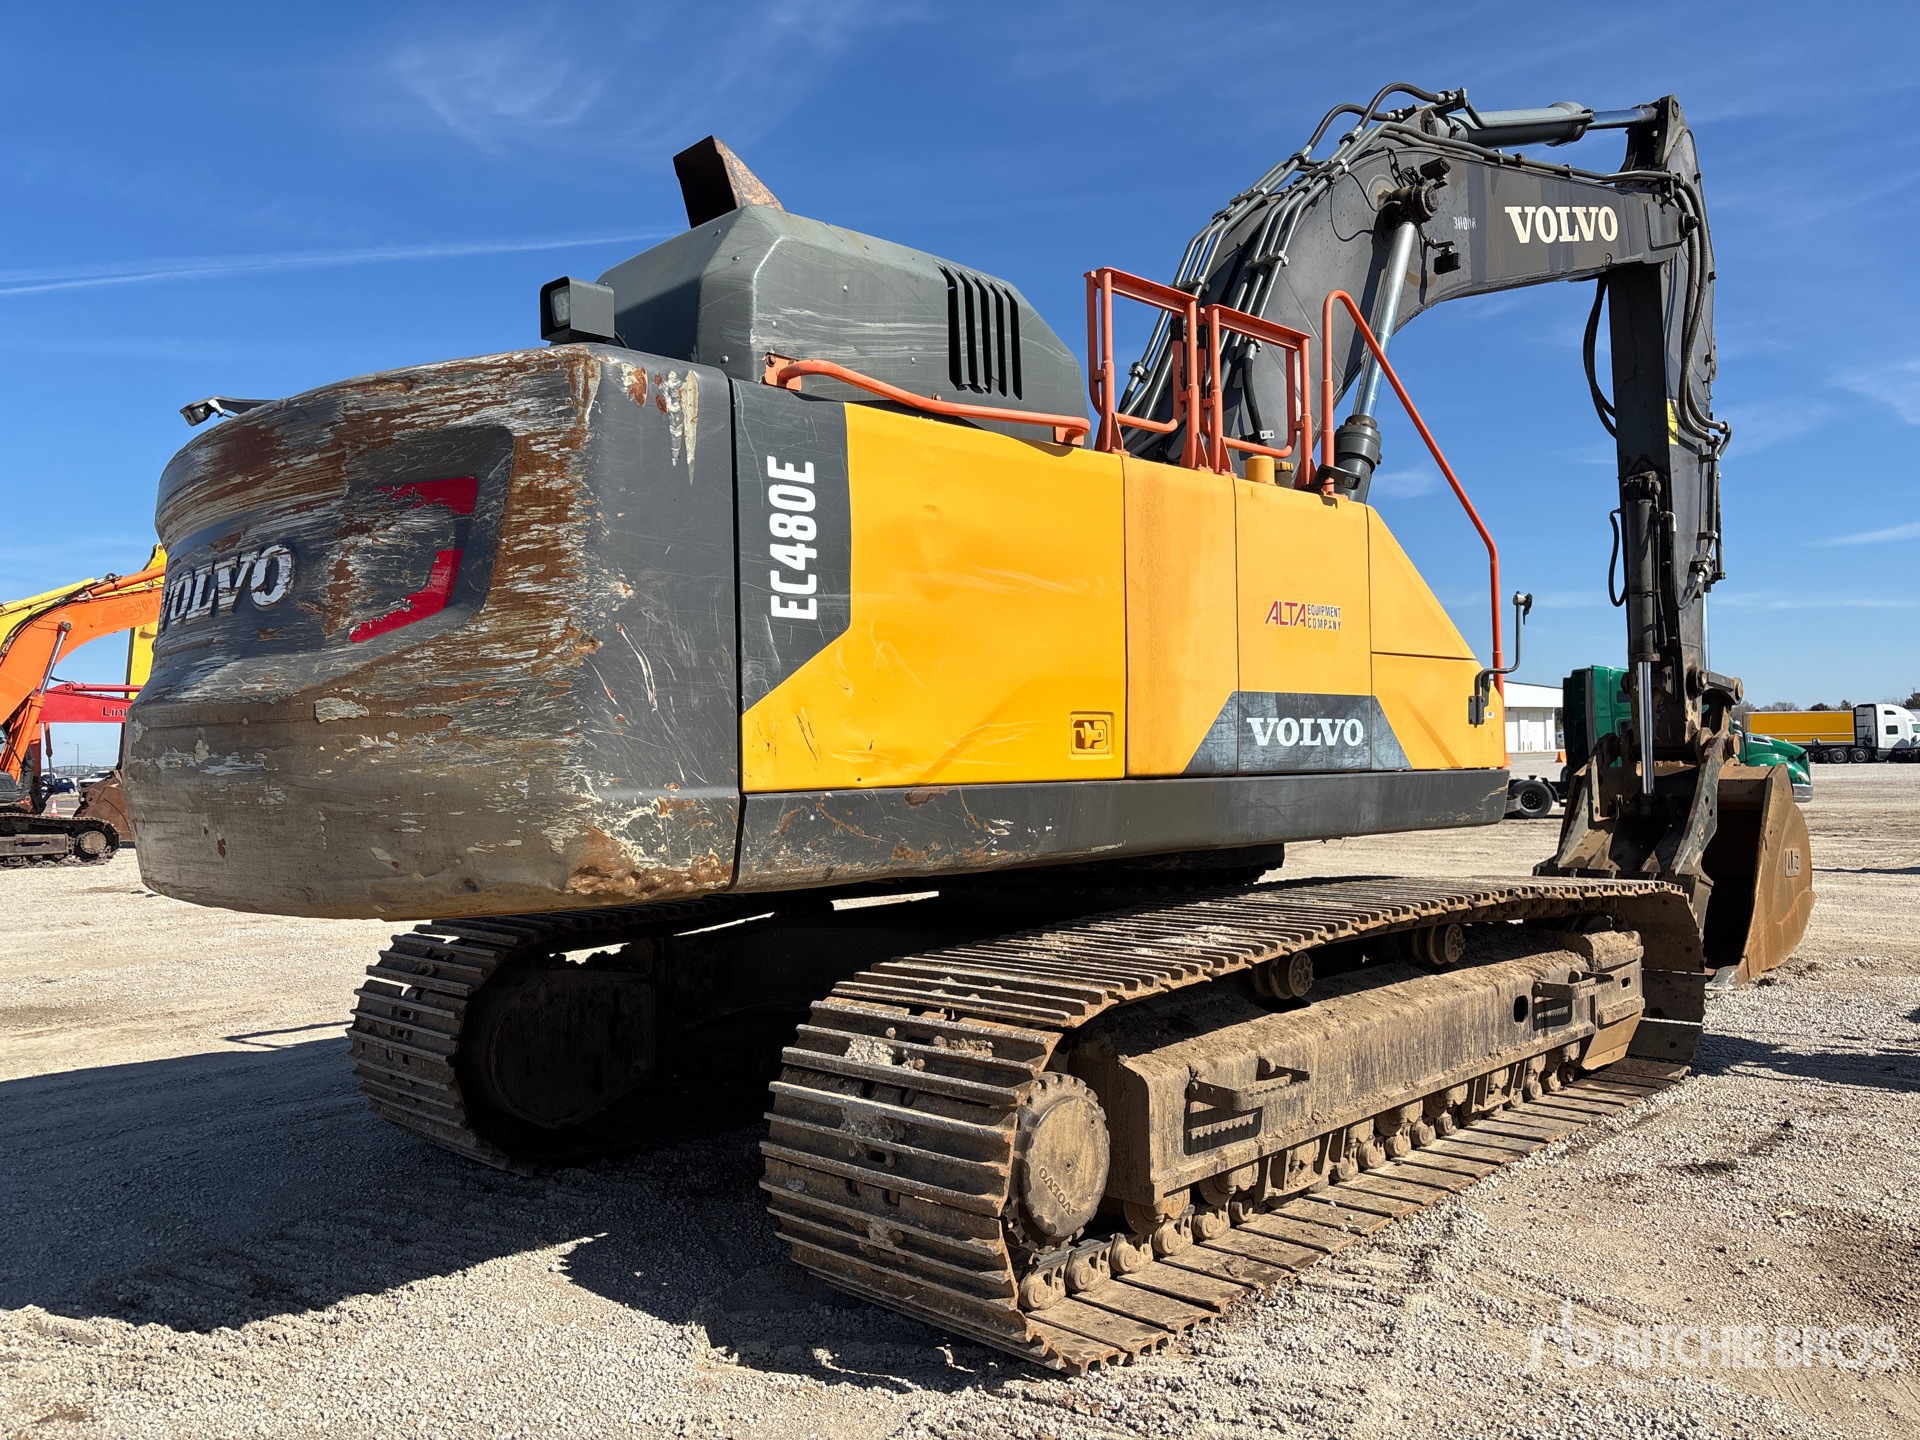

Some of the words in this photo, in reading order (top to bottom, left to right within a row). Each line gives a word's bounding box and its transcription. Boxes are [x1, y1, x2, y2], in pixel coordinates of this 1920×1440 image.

[1504, 205, 1618, 244] VOLVO
[767, 455, 817, 620] EC480E
[158, 543, 293, 631] VOLVO
[1265, 600, 1306, 627] ALTA
[1307, 604, 1341, 618] EQUIPMENT
[1307, 617, 1341, 631] COMPANY
[1246, 717, 1364, 747] VOLVO
[1039, 1167, 1072, 1216] VOLVO
